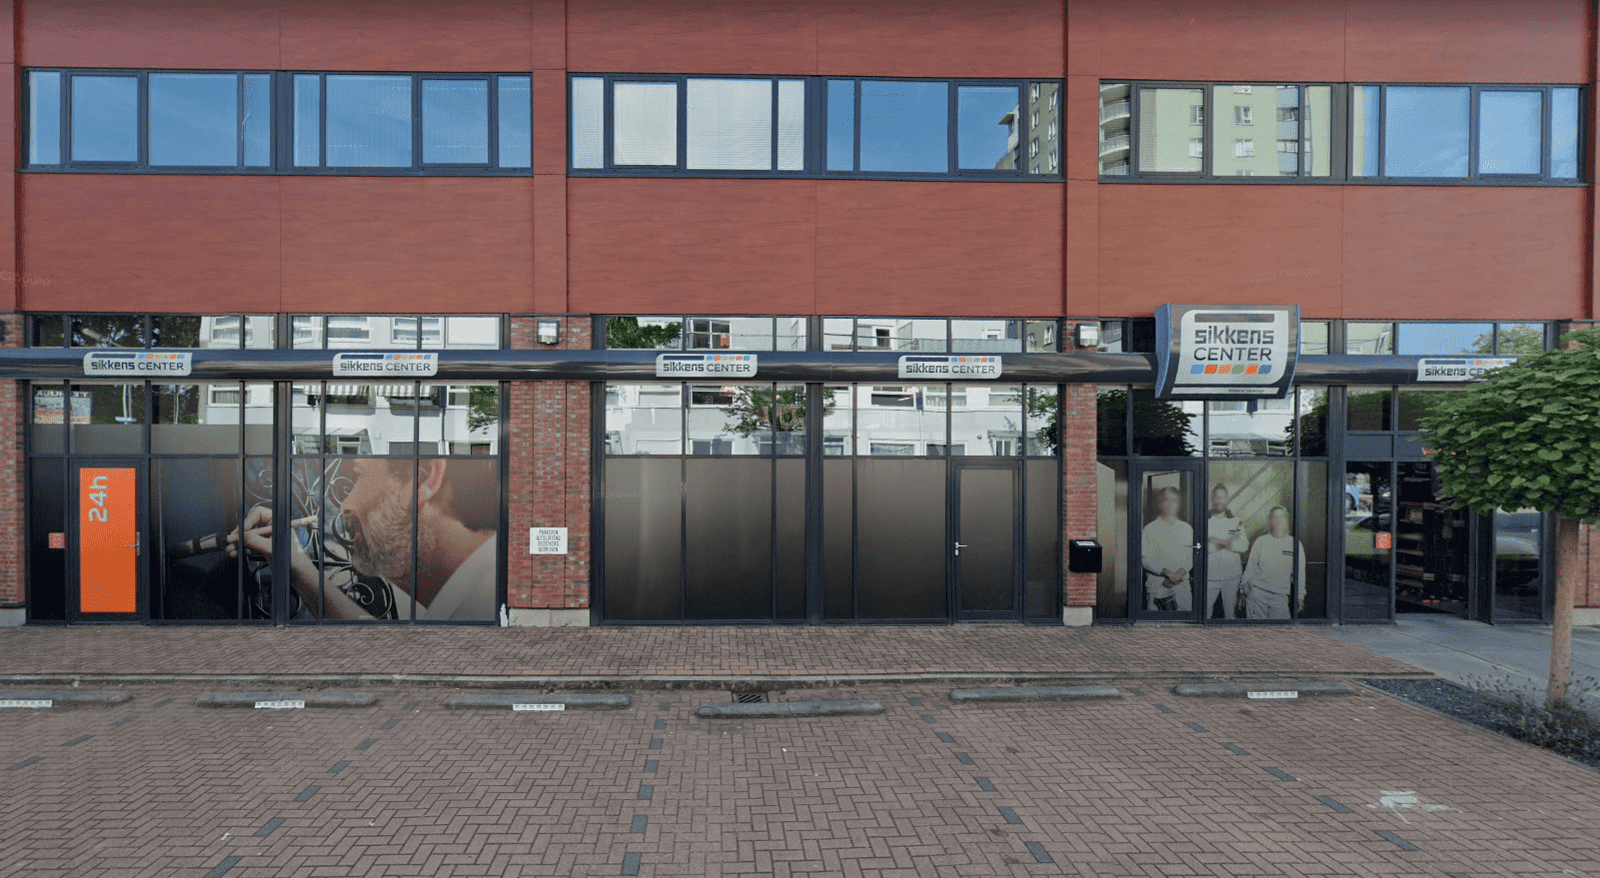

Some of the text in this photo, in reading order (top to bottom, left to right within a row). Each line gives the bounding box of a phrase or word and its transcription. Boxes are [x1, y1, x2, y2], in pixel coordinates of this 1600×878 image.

[1194, 325, 1275, 344] sikkens
[1193, 347, 1272, 361] CENTER
[91, 360, 184, 371] sikkens CENTER
[340, 361, 431, 371] sikkens CENTER
[663, 361, 750, 372] sikkens CENTER
[906, 363, 995, 374] sikkens CENTER
[1425, 366, 1466, 376] sikkens
[88, 475, 109, 523] 24h
